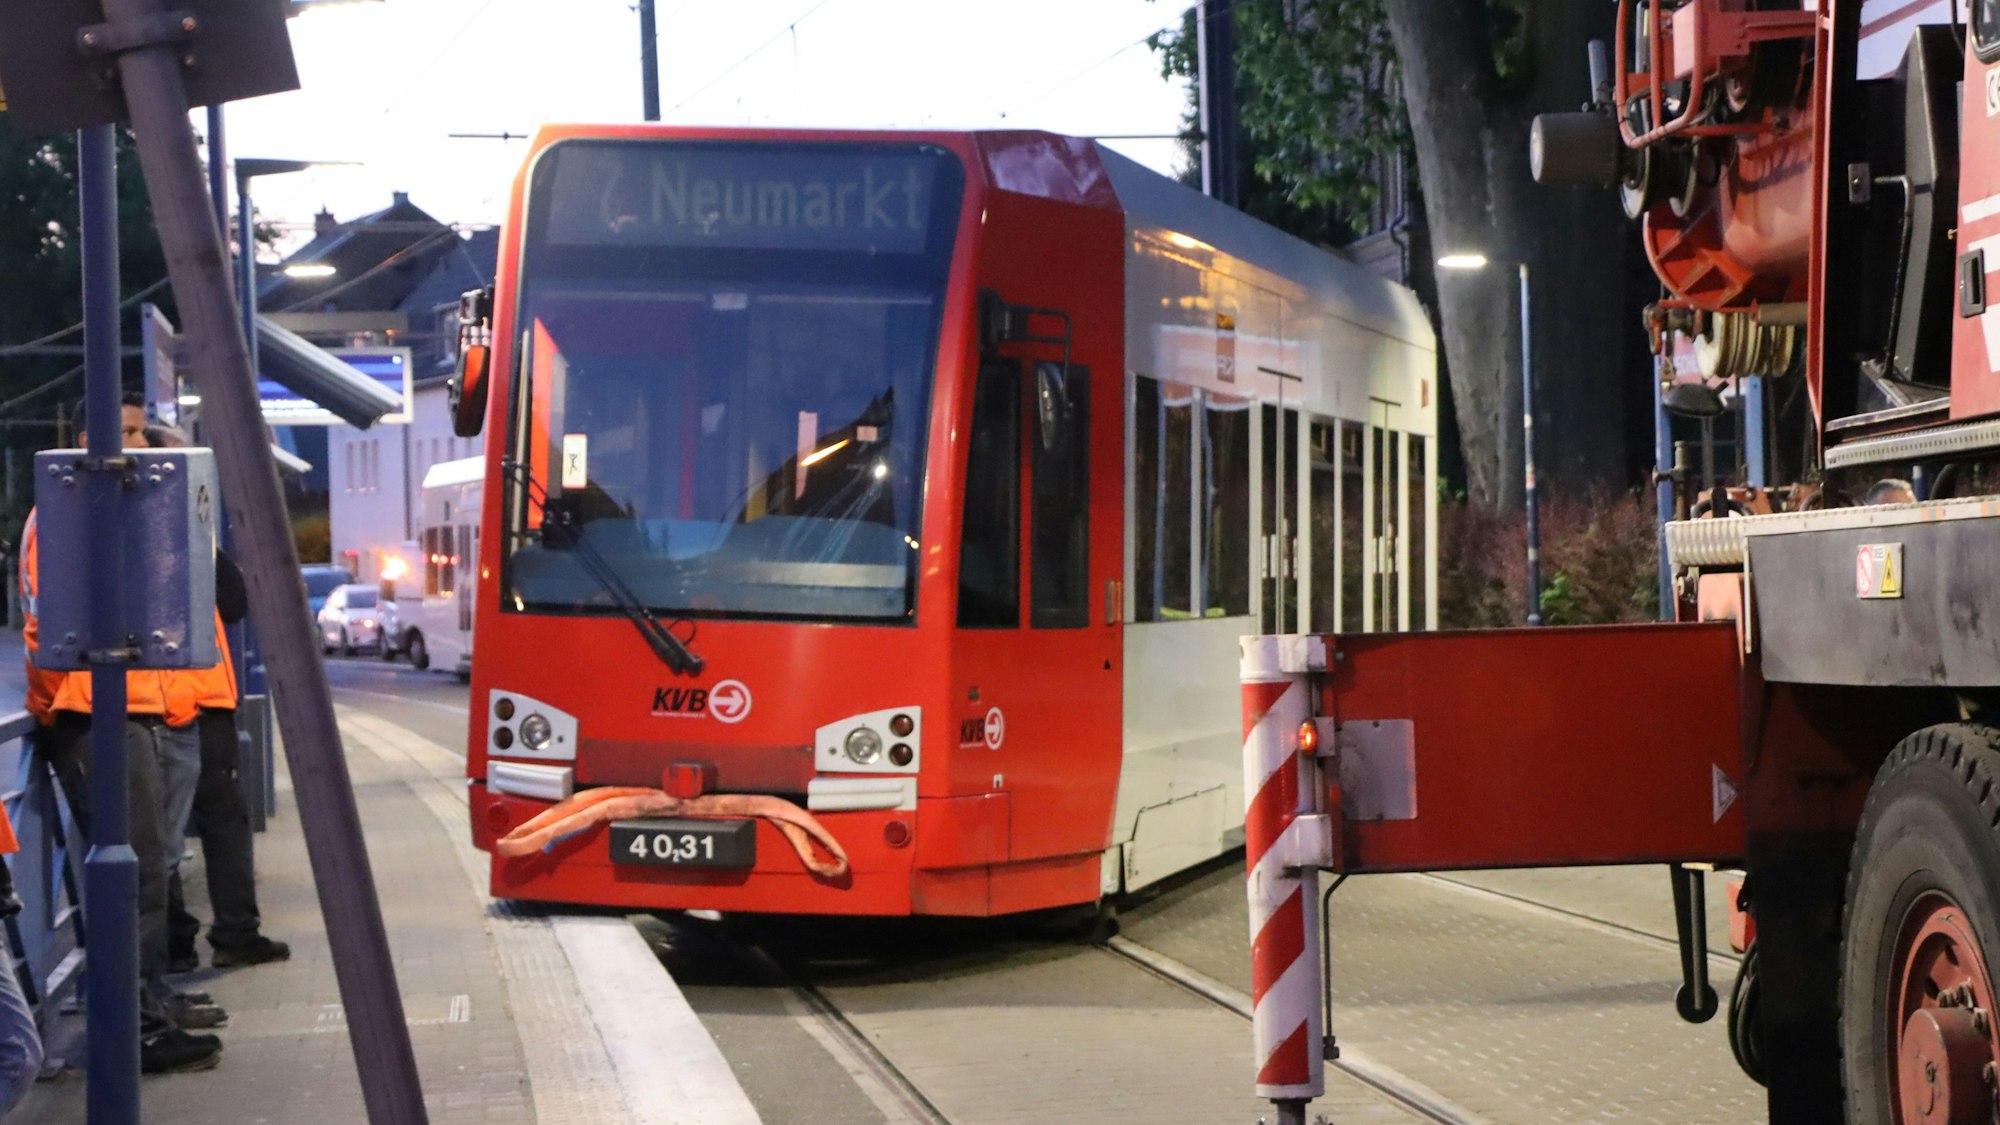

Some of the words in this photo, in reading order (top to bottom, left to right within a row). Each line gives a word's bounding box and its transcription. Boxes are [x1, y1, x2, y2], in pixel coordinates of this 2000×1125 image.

[652, 162, 922, 229] Neumarkt
[652, 687, 707, 712] KVB
[960, 717, 985, 743] KVB
